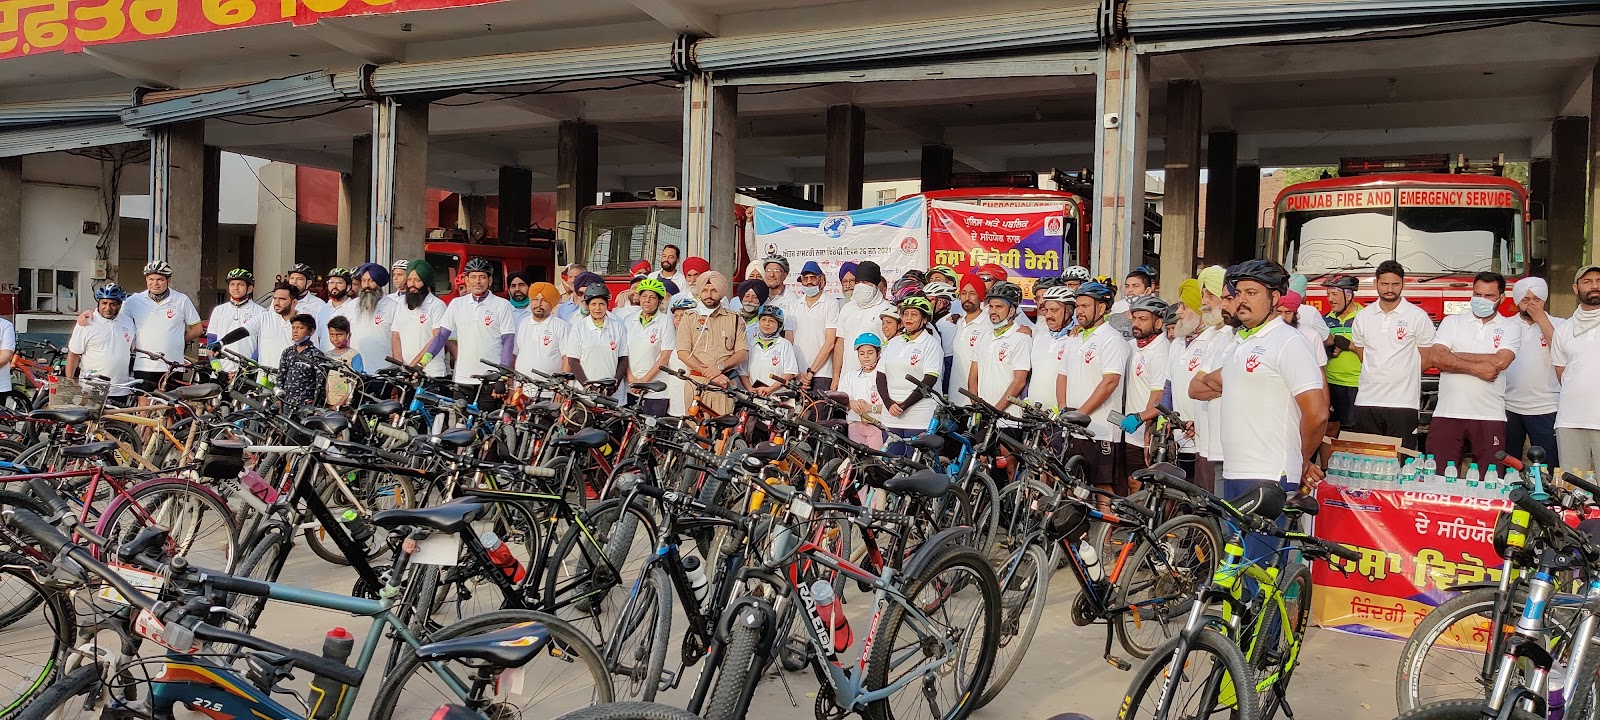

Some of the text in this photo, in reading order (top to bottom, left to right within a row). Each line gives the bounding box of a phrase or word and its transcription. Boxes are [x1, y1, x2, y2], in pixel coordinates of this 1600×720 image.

[1287, 191, 1512, 210] PUNJAB FIRE AND EMERGENCY SERVICE
[859, 247, 867, 255] 26
[878, 246, 893, 255] 2021
[1024, 248, 1060, 271] ਰੈਲੀ
[1415, 512, 1431, 535] ਦੇ
[192, 697, 224, 712] 27.5
[1116, 694, 1131, 720] XIS
